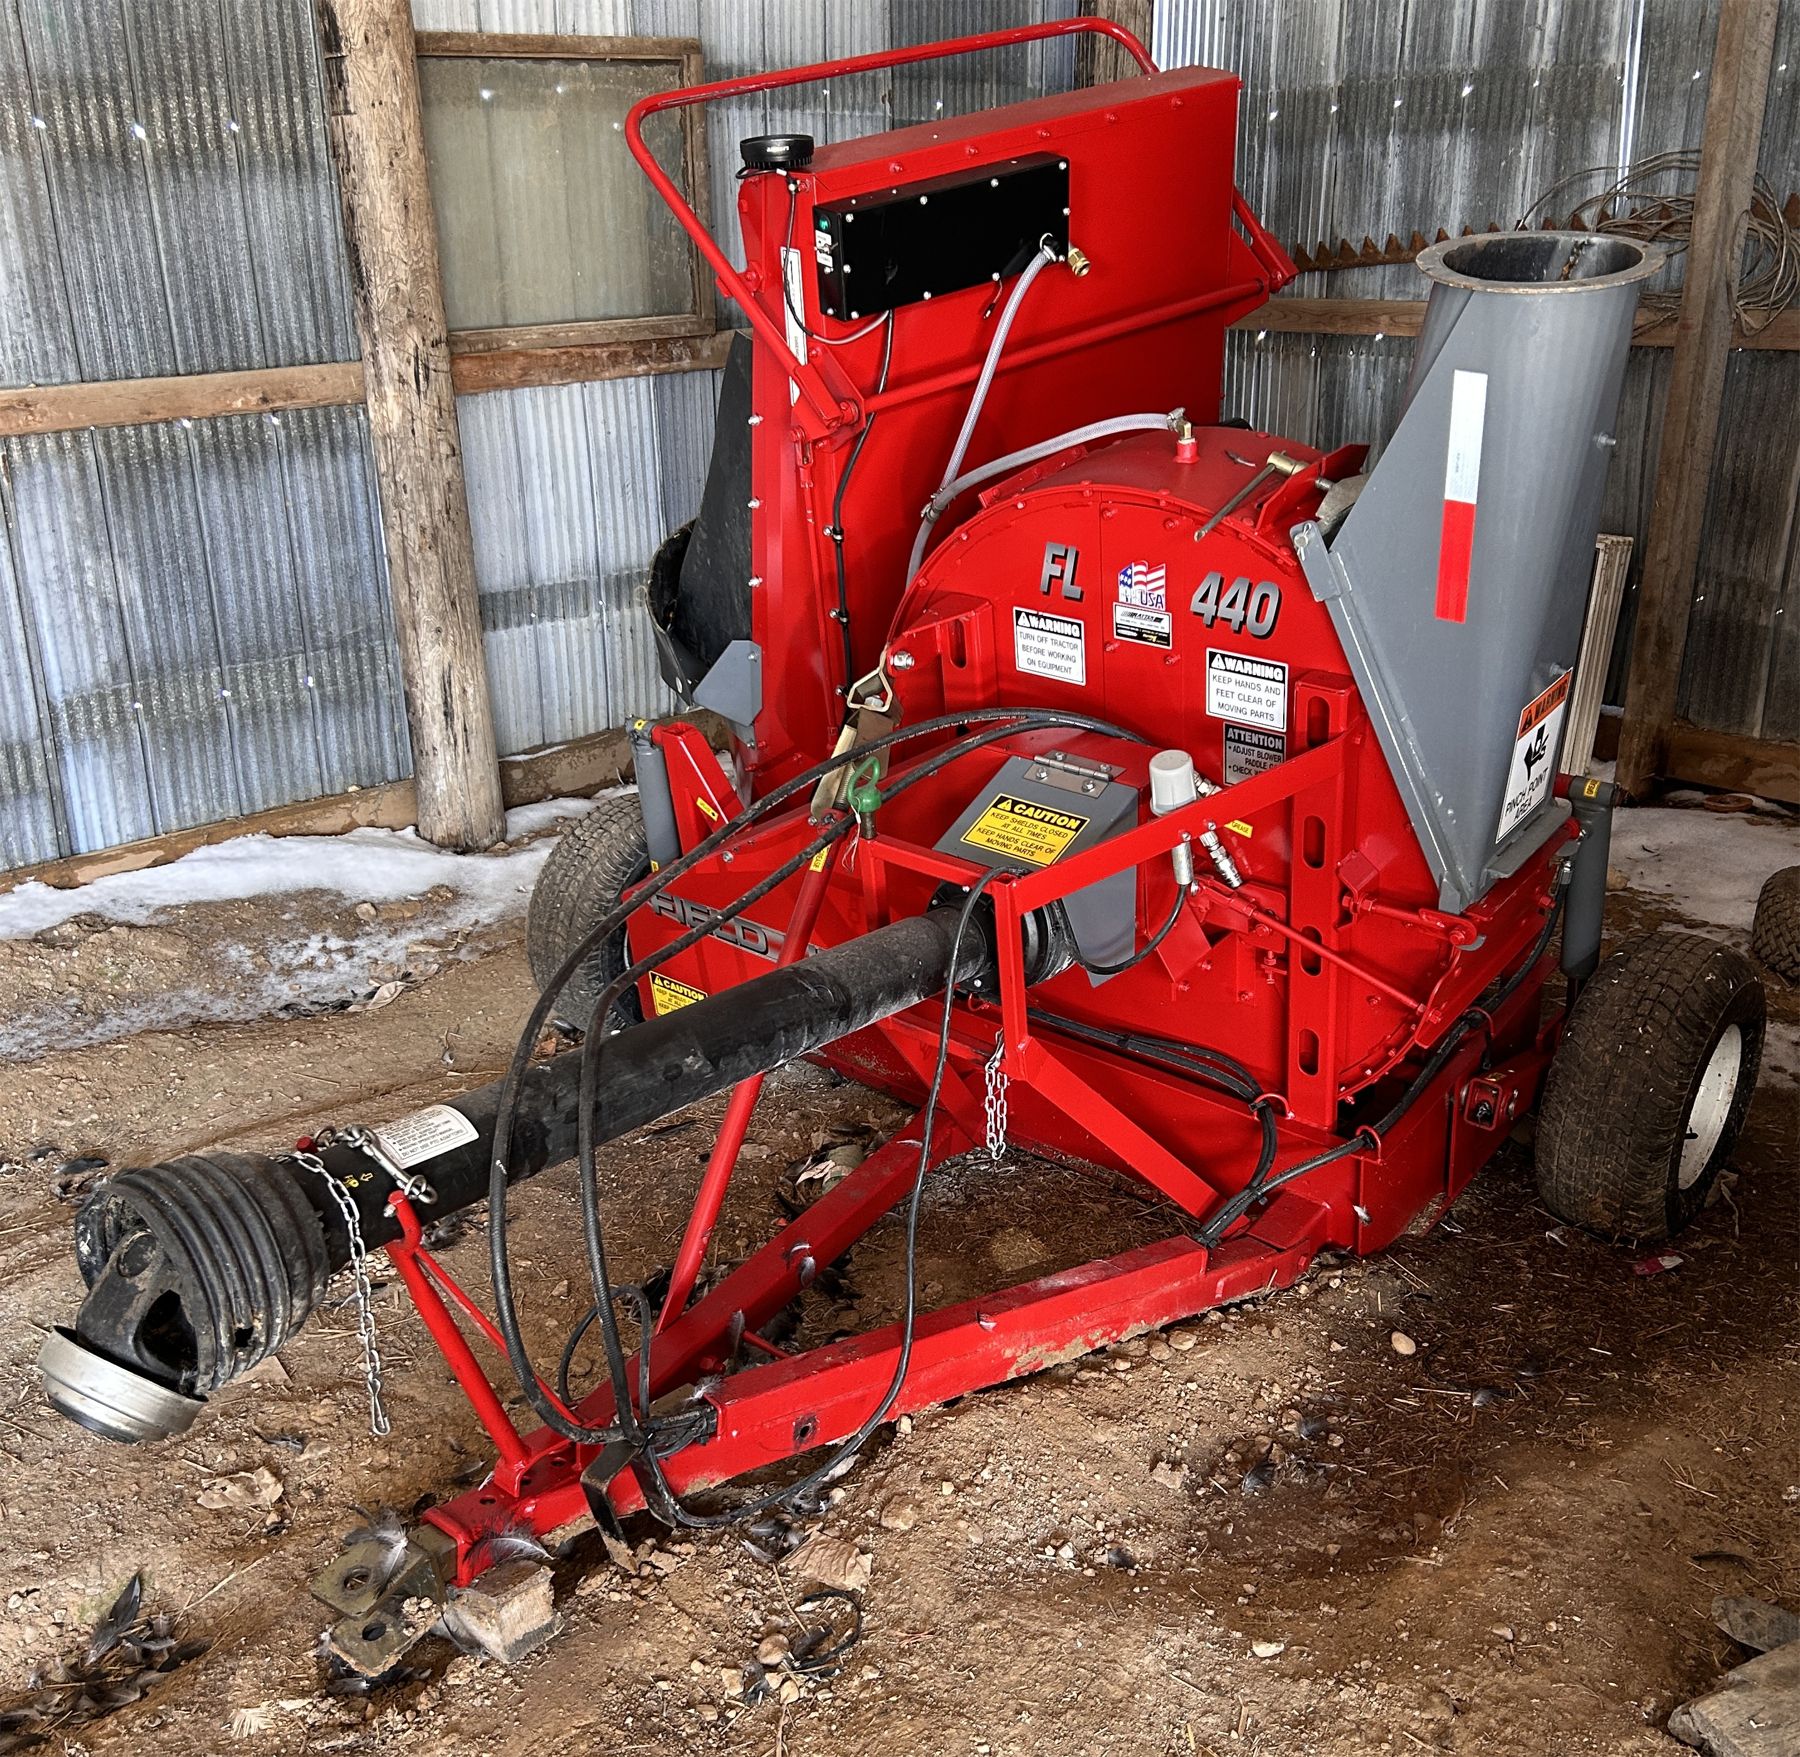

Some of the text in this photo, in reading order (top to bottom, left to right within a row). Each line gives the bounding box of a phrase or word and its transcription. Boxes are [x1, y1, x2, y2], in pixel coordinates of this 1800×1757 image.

[1040, 542, 1084, 602] FL
[1140, 590, 1164, 609] USA
[1190, 571, 1282, 639] 440
[1028, 614, 1080, 638] WARNING
[1019, 631, 1078, 651] TURN OFF TRACTOR
[1022, 644, 1076, 663] BEFORE WORKING
[1027, 658, 1072, 674] ON EQUIPMENT
[1224, 656, 1283, 682] WARNING
[1212, 674, 1281, 696] KEEP HANDS AND
[1216, 688, 1276, 708] FEET CLEAR OF
[1217, 702, 1275, 722] MOVING PARTS
[1227, 727, 1283, 750] ATTENTION
[1232, 745, 1282, 763] ADJUST BLOWER
[1245, 758, 1268, 770] PADDLE
[1232, 764, 1253, 776] CHECK
[1505, 767, 1549, 816] PINCH POINT
[990, 811, 1069, 839] KEEP SHIELDS CLOSED
[1013, 803, 1081, 830] CAUTION
[976, 827, 1056, 855] KEEP HANDS CLEAR OF
[1026, 829, 1047, 840] TIMES
[985, 837, 1036, 857] MOVING PARTS
[663, 979, 705, 1001] CAUTION
